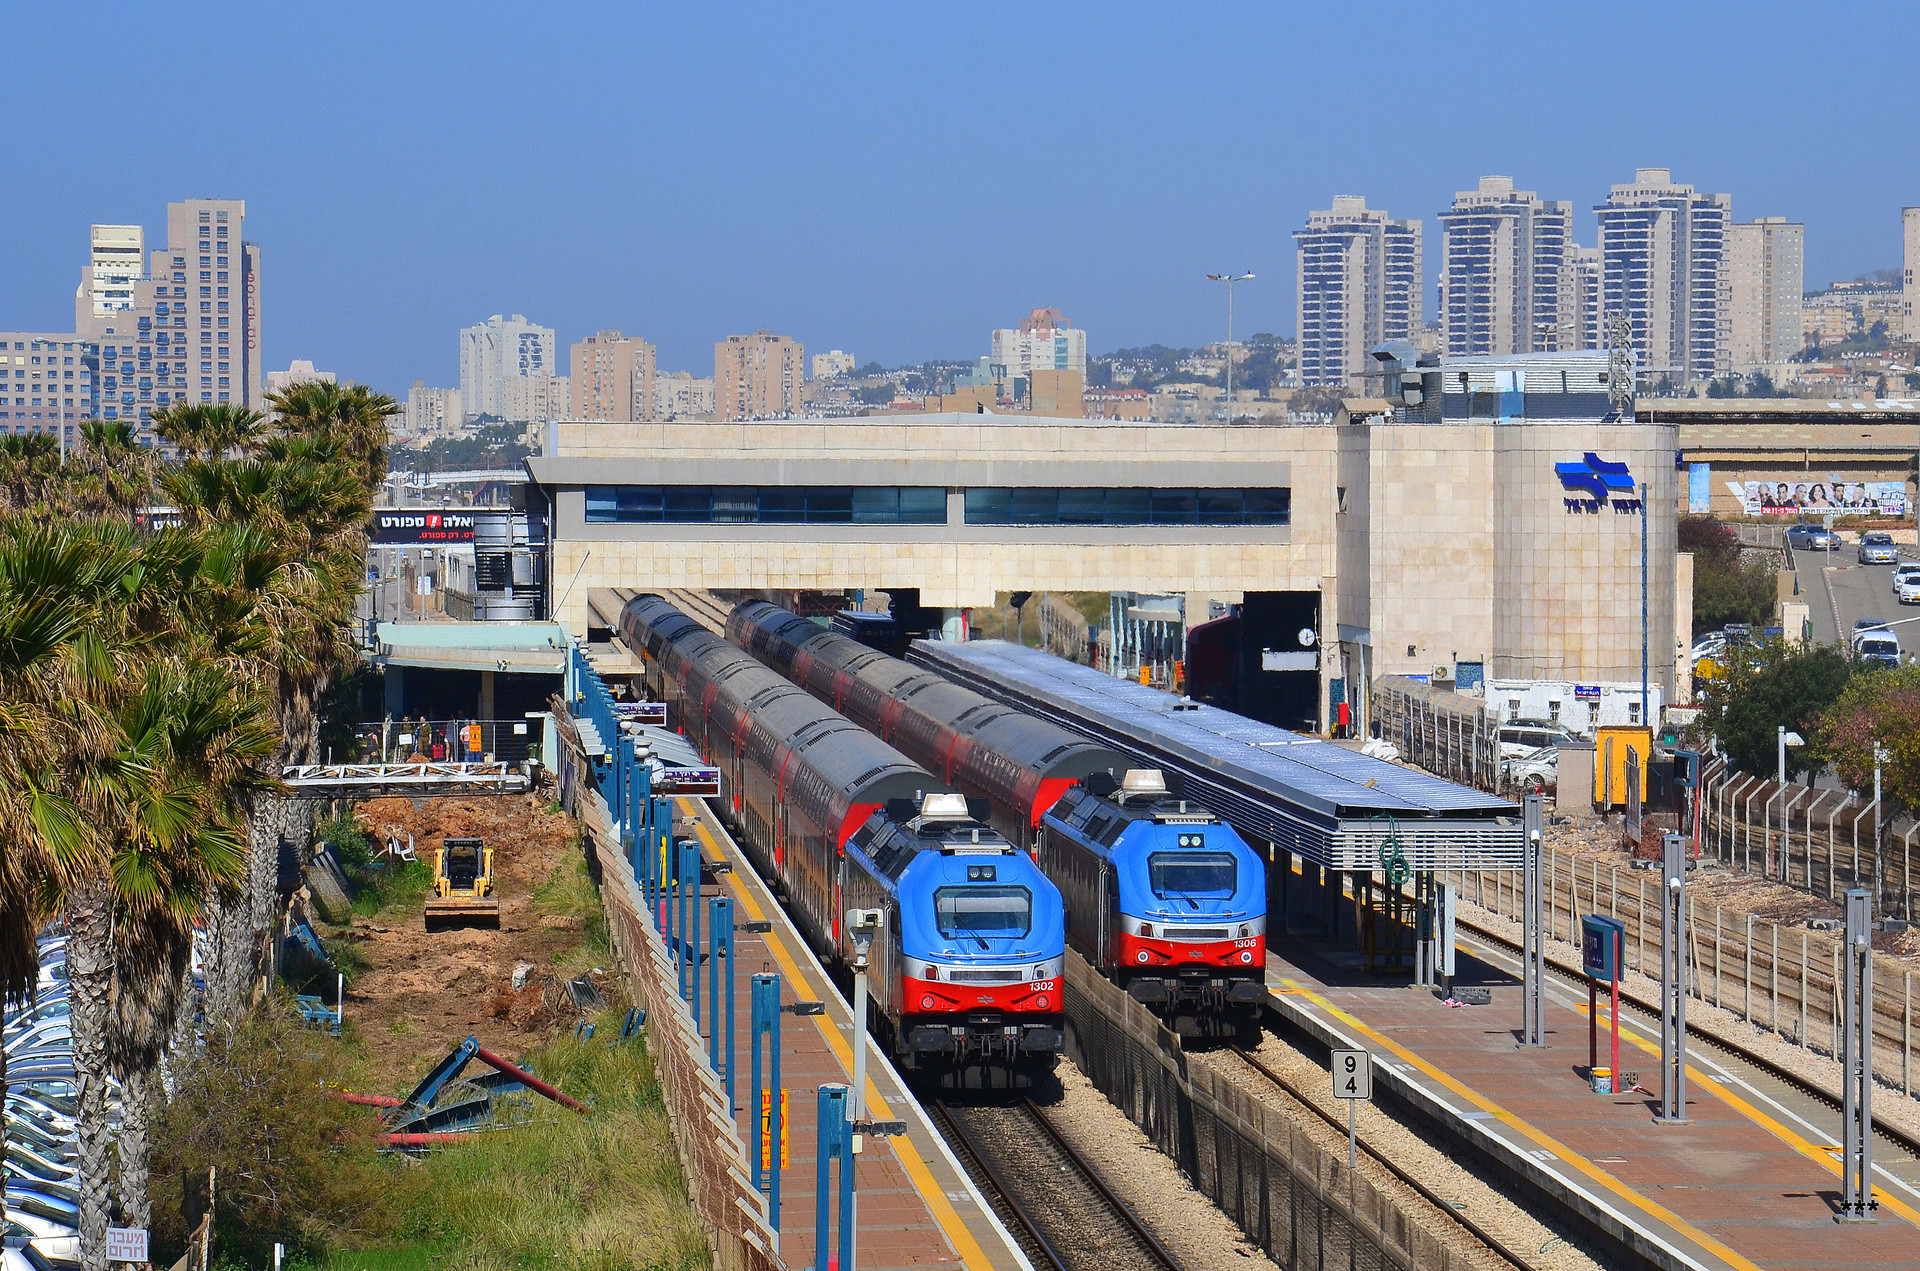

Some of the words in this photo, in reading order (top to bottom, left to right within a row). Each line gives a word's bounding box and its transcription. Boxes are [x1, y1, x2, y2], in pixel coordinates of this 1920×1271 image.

[381, 516, 425, 528] ספורט
[1234, 939, 1257, 948] 1306
[1029, 981, 1054, 991] 1302
[1344, 1055, 1357, 1073] 9
[1345, 1076, 1358, 1094] 4
[109, 1231, 144, 1245] מעבר
[109, 1245, 145, 1258] חרום
